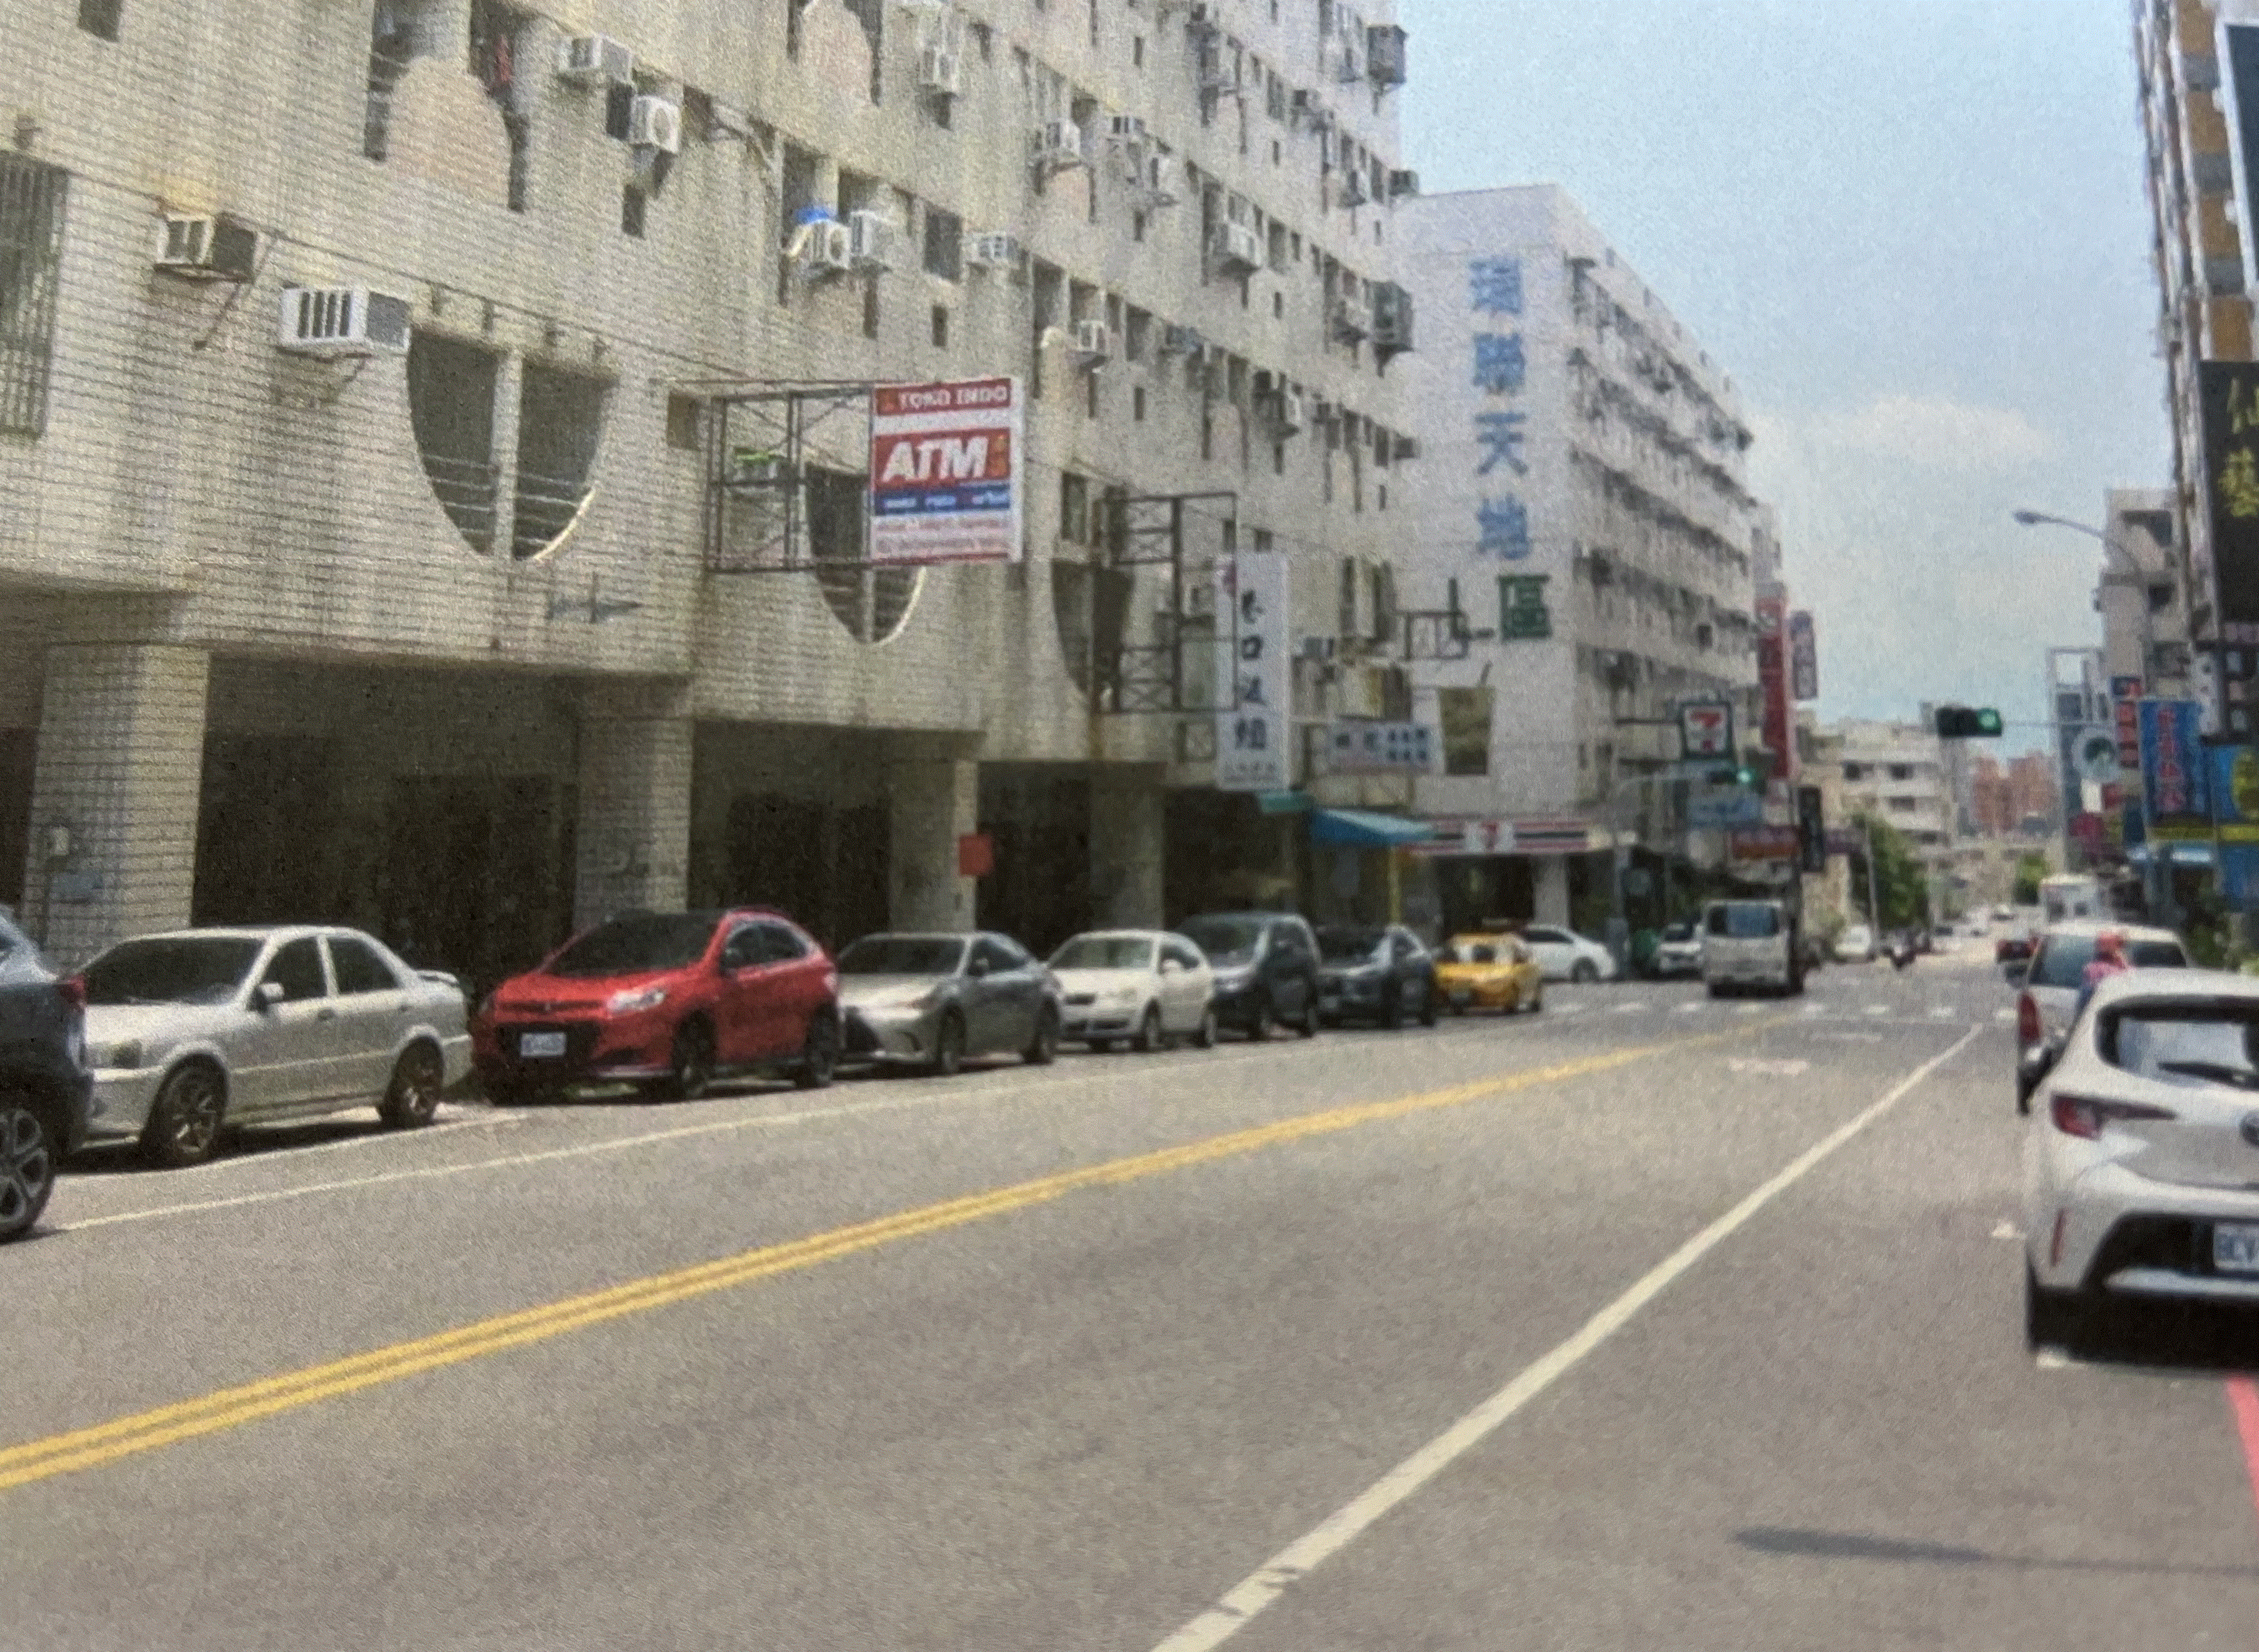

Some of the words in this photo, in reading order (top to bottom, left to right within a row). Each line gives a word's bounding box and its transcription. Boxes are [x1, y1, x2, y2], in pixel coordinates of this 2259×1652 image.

[898, 389, 951, 409] TOKO
[956, 385, 1008, 405] INDO
[880, 436, 989, 483] ATM
